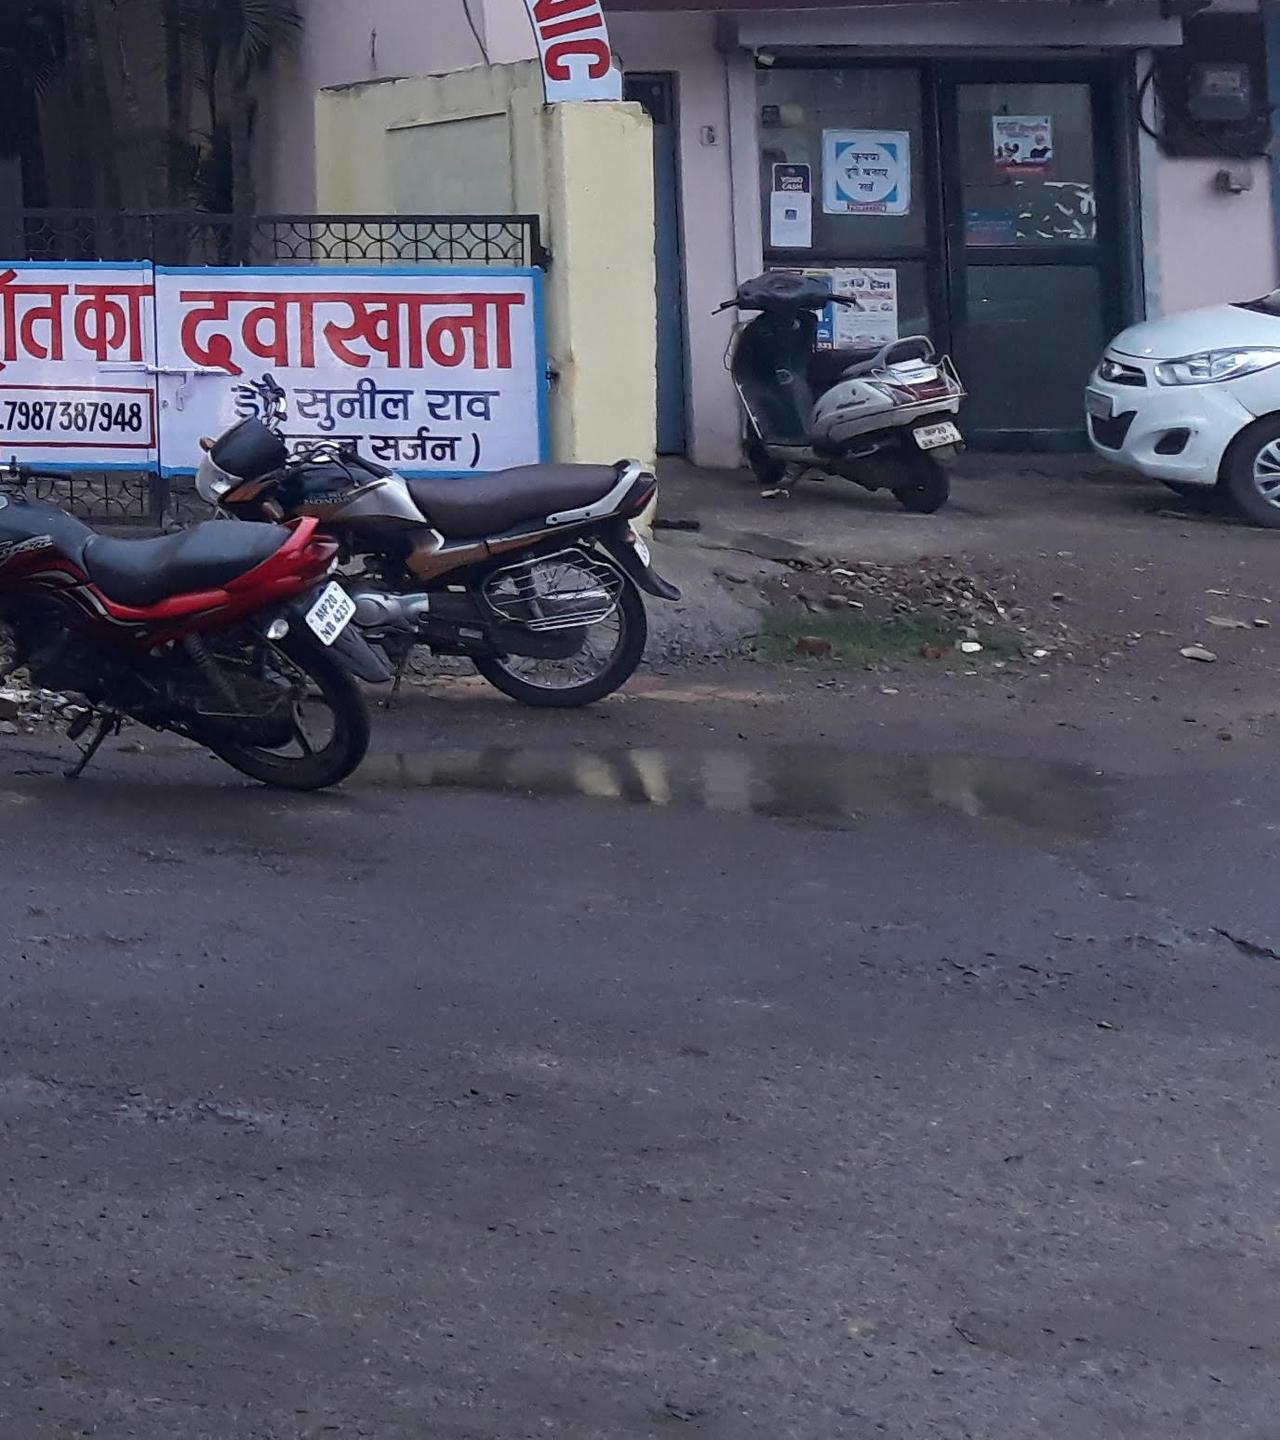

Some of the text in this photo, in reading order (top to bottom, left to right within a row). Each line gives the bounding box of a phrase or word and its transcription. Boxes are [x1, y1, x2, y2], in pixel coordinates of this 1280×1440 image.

[74, 284, 155, 362] का
[179, 291, 525, 375] दवाखाना
[294, 378, 414, 431] सुनील
[424, 389, 500, 422] राव
[315, 594, 337, 622] MP20
